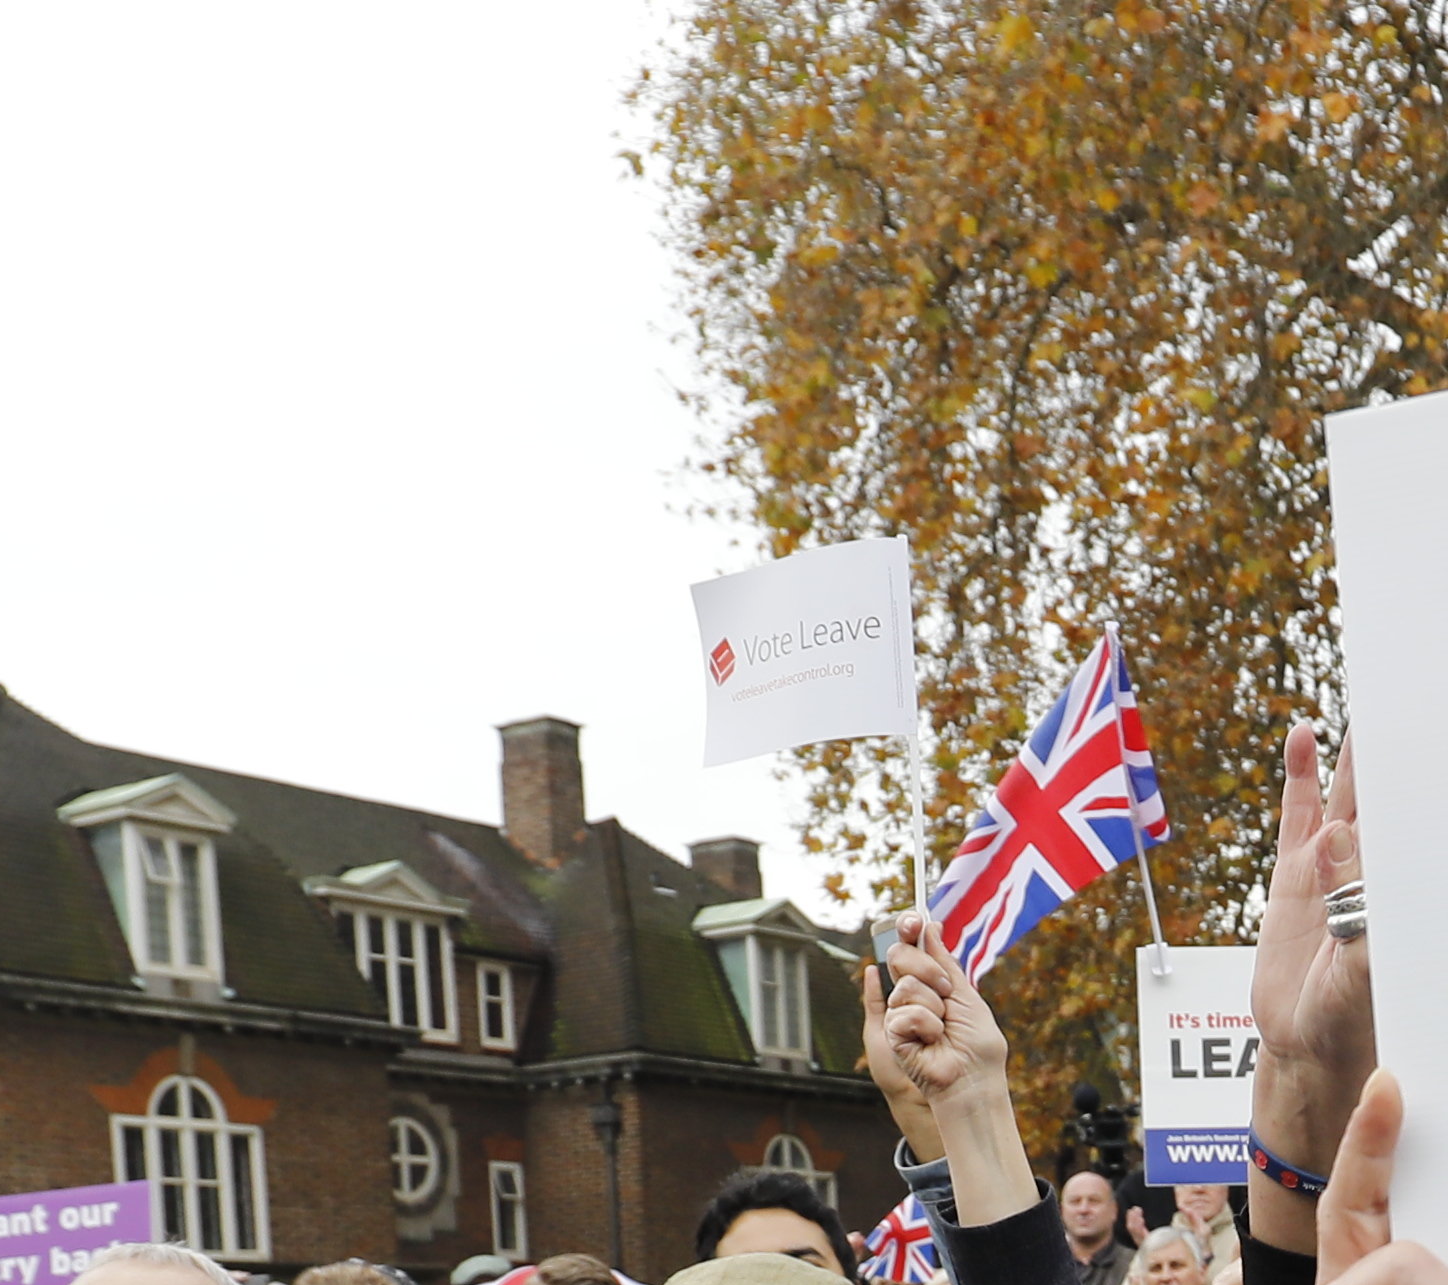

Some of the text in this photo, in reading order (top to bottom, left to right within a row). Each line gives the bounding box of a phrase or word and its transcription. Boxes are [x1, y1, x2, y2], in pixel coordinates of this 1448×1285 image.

[743, 615, 881, 666] Vote Leave
[730, 663, 854, 702] voteleavetakecontrol.org
[1169, 1012, 1254, 1029] It's time
[58, 1201, 120, 1230] our
[50, 1242, 116, 1276] ba
